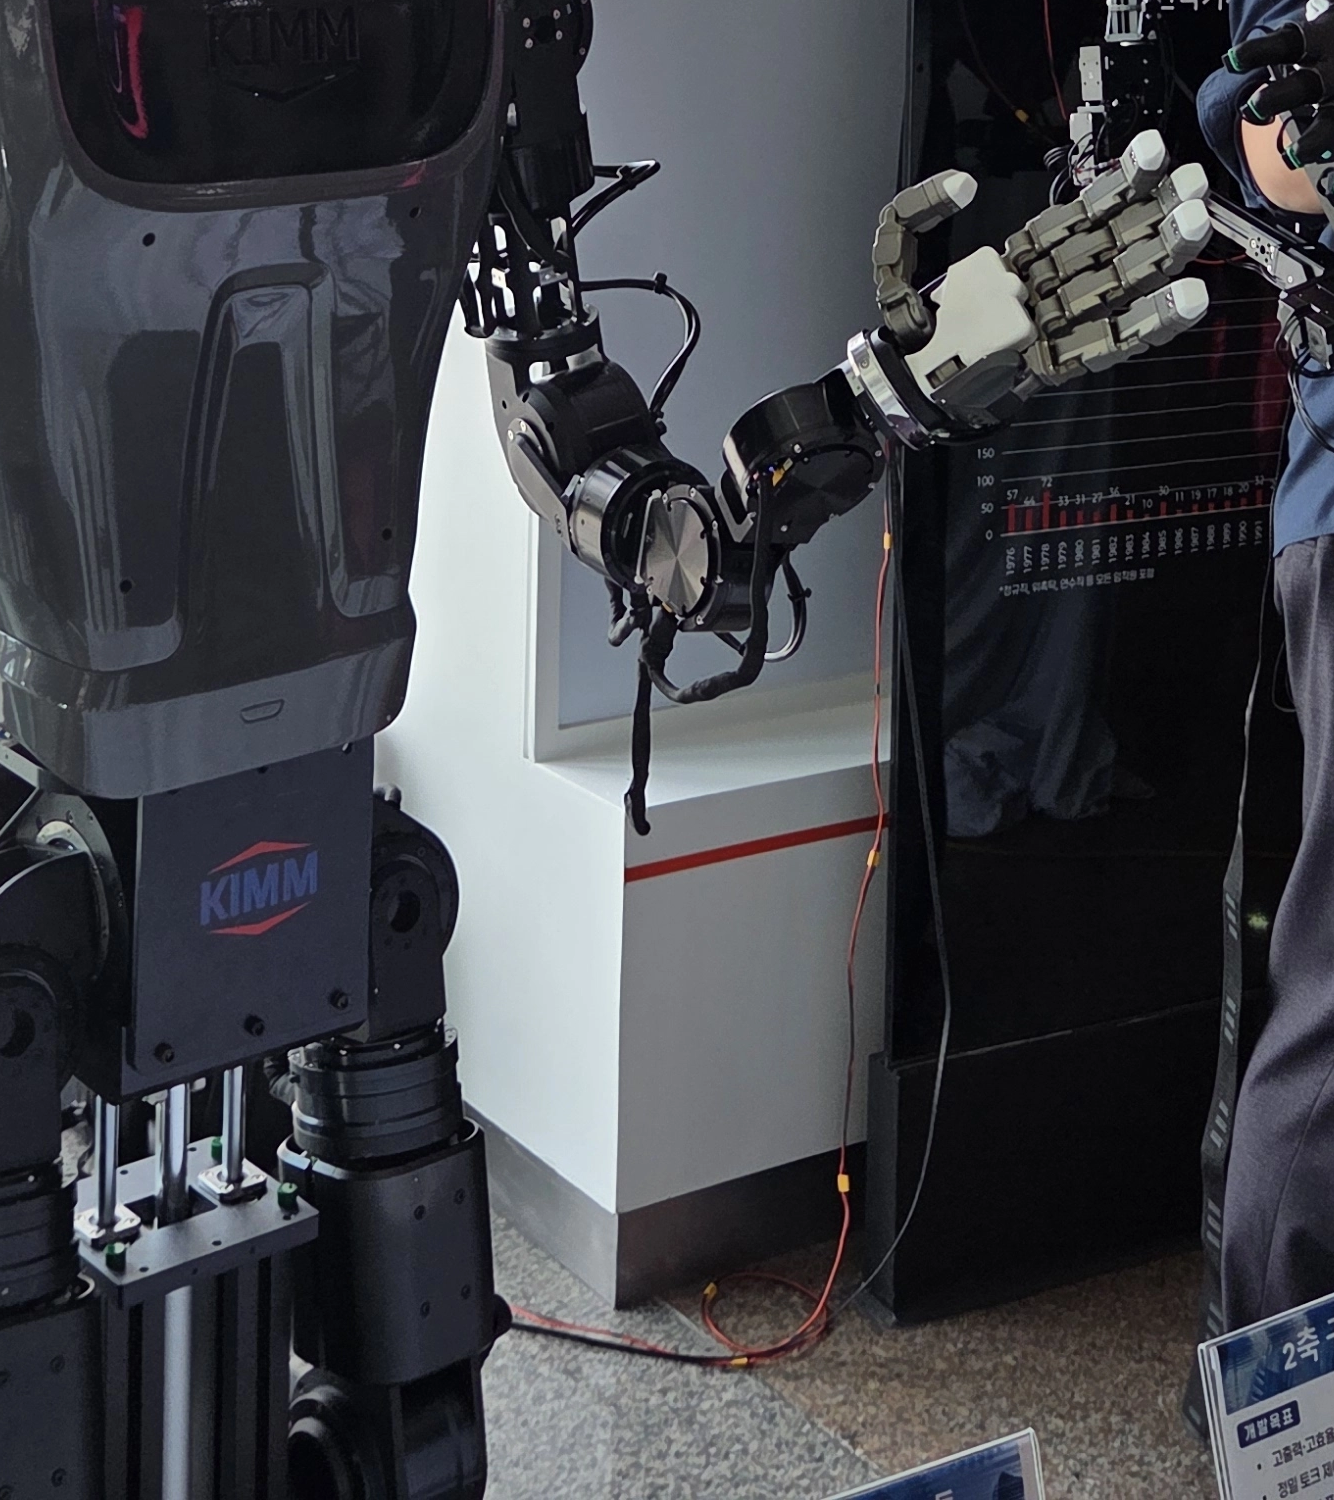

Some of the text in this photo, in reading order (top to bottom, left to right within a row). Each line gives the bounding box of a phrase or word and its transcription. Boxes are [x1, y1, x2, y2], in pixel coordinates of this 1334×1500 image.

[207, 6, 362, 68] KIMM
[977, 447, 995, 460] 150
[977, 475, 995, 488] 100
[1007, 489, 1018, 500] 57
[1040, 476, 1053, 487] 72
[1058, 495, 1069, 507] 33
[1075, 494, 1085, 504] 31
[1125, 494, 1135, 505] 21
[1142, 498, 1153, 509] 10
[1175, 491, 1184, 502] 11
[1191, 489, 1201, 500] 19
[981, 502, 994, 514] 50
[985, 529, 993, 541] 0
[199, 849, 319, 927] KIMM
[1282, 1326, 1320, 1371] 2축
